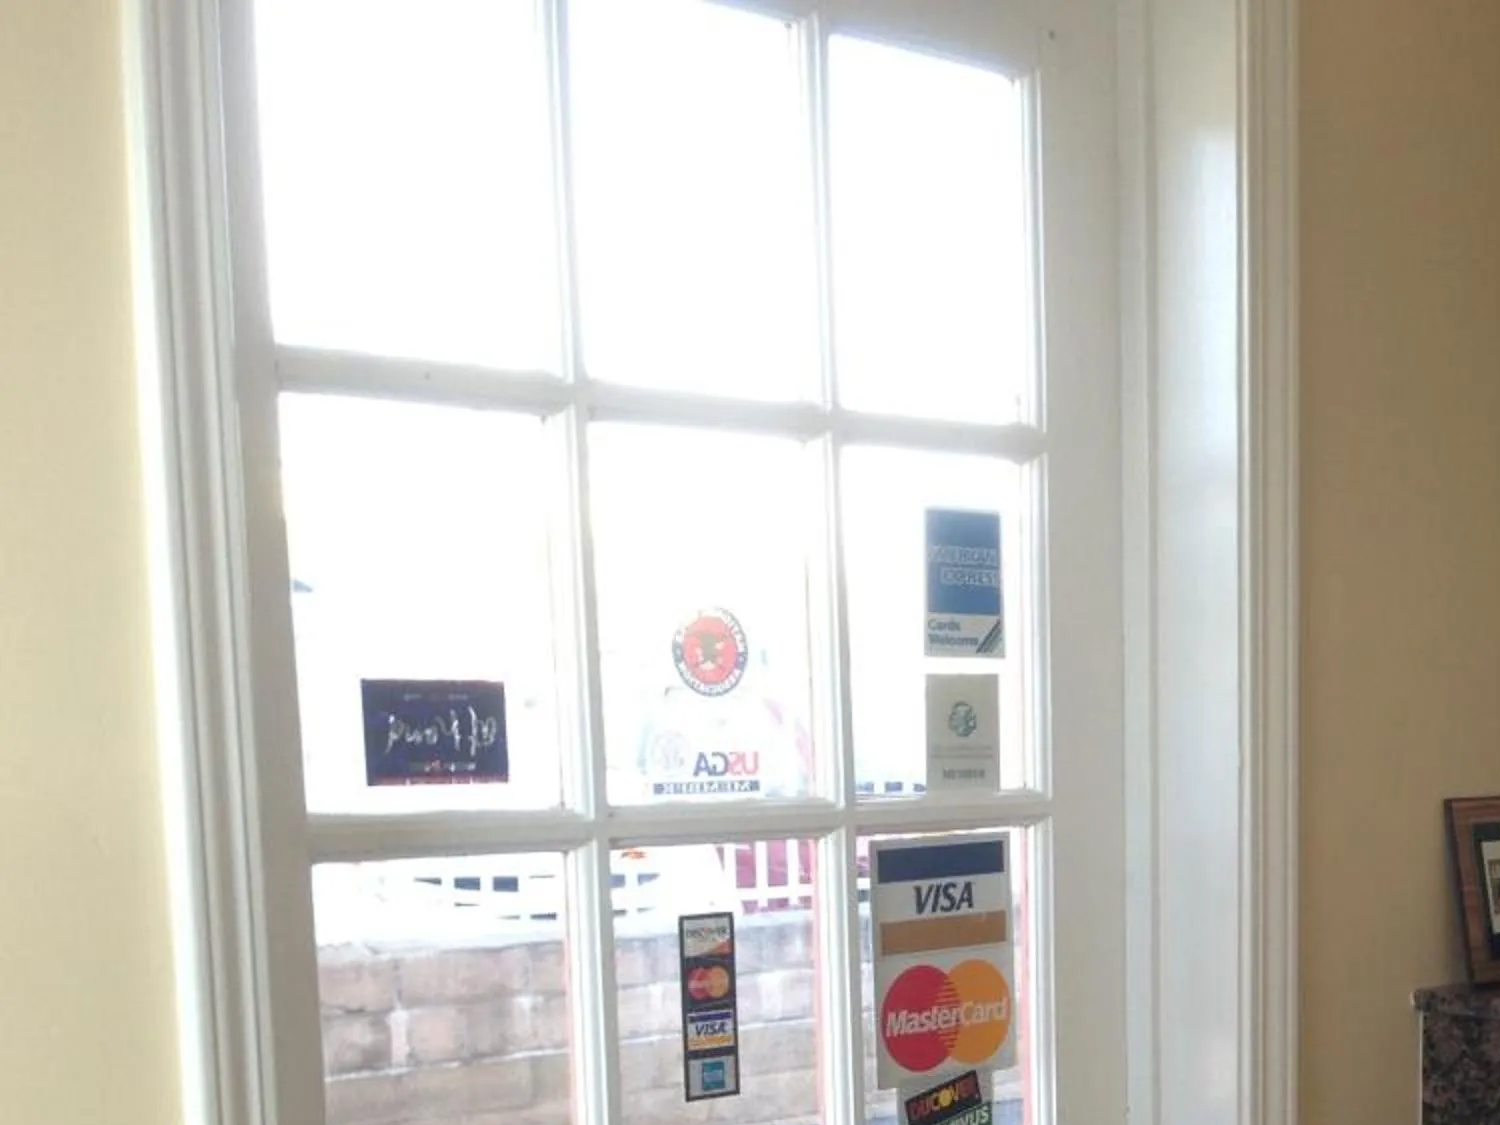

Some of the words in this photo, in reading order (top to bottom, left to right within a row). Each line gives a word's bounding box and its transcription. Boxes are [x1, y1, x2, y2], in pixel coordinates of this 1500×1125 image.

[913, 880, 975, 915] VISA
[694, 1021, 728, 1036] VISA
[886, 996, 1008, 1037] MasterCard
